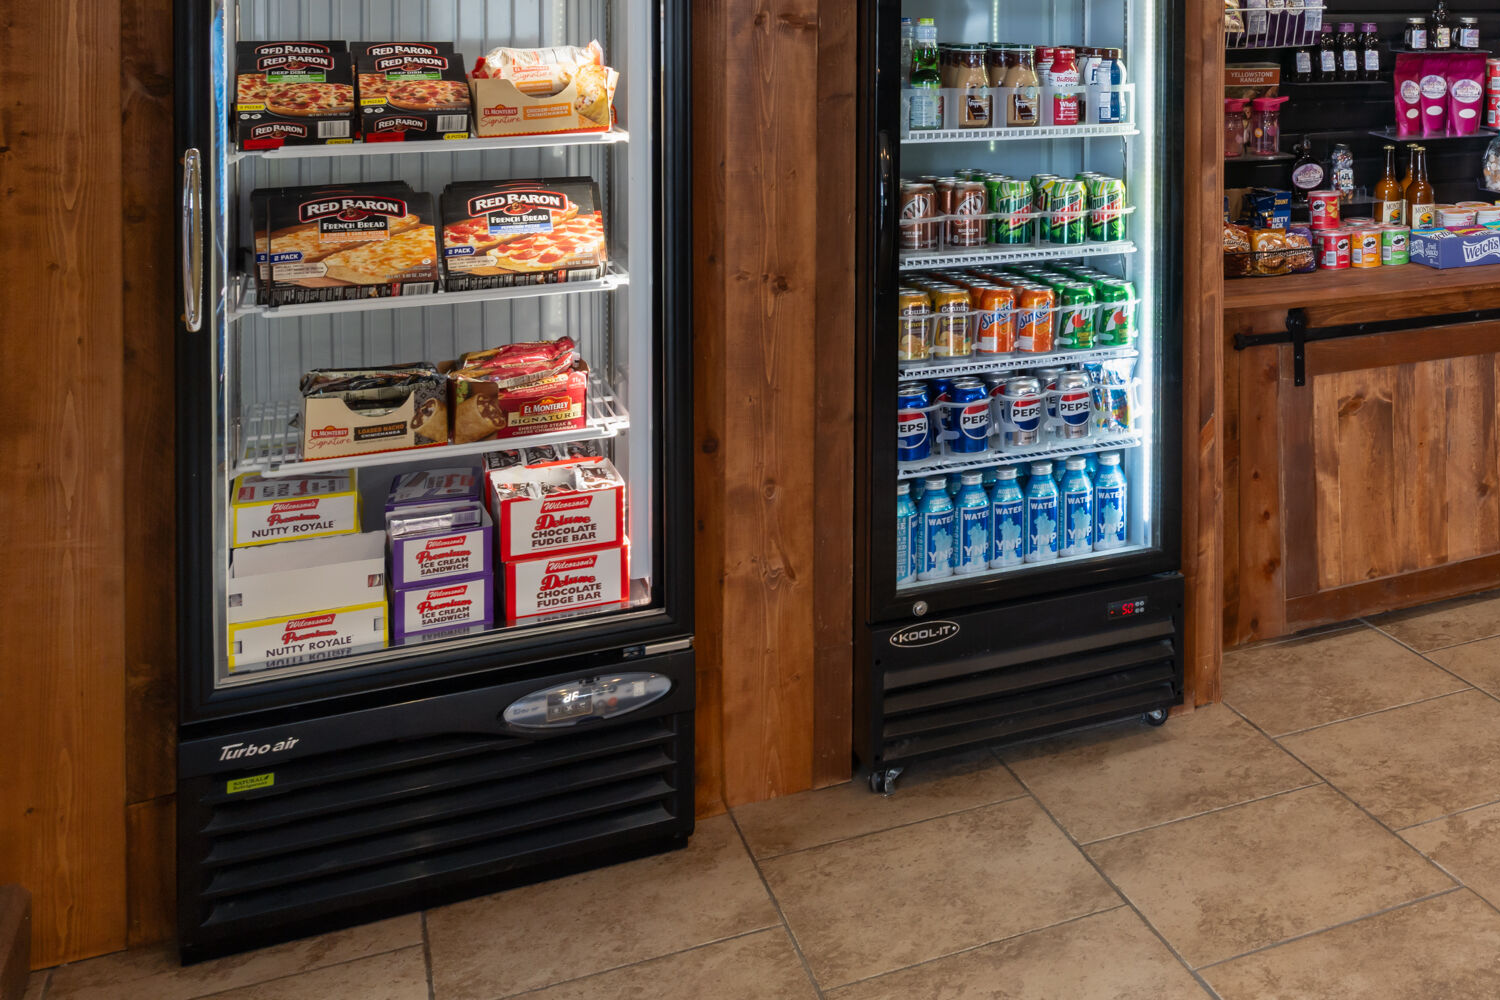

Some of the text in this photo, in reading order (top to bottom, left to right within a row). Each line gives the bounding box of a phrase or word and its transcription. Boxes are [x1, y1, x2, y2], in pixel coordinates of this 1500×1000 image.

[264, 56, 328, 67] RED BARON
[381, 57, 442, 68] RED BARON
[307, 200, 399, 216] RED BARON
[475, 194, 560, 211] RED BARON
[491, 214, 548, 223] FRENCH BREAD
[323, 221, 385, 230] FRENCH BREAD
[1465, 238, 1499, 259] Welch's
[533, 402, 568, 412] MONTEREY
[511, 412, 578, 425] SIGNATURE
[252, 521, 334, 538] NUTTY ROYALE
[532, 524, 597, 539] CHOCOLATE
[532, 532, 596, 548] FUDGE BAR
[996, 538, 1022, 550] YNP
[1031, 533, 1057, 544] YNP
[964, 544, 989, 556] YNP
[421, 557, 469, 569] ICE CREAM
[421, 563, 469, 576] SANDWICH
[536, 583, 602, 600] CHOCOLATE
[537, 591, 601, 608] FUDGE BAR
[422, 606, 470, 619] ICE CREAM
[422, 613, 470, 625] SANDWICH
[899, 625, 951, 643] KOOL-IT
[266, 636, 352, 658] NUTTY ROYALE
[220, 737, 300, 761] Turbo air
